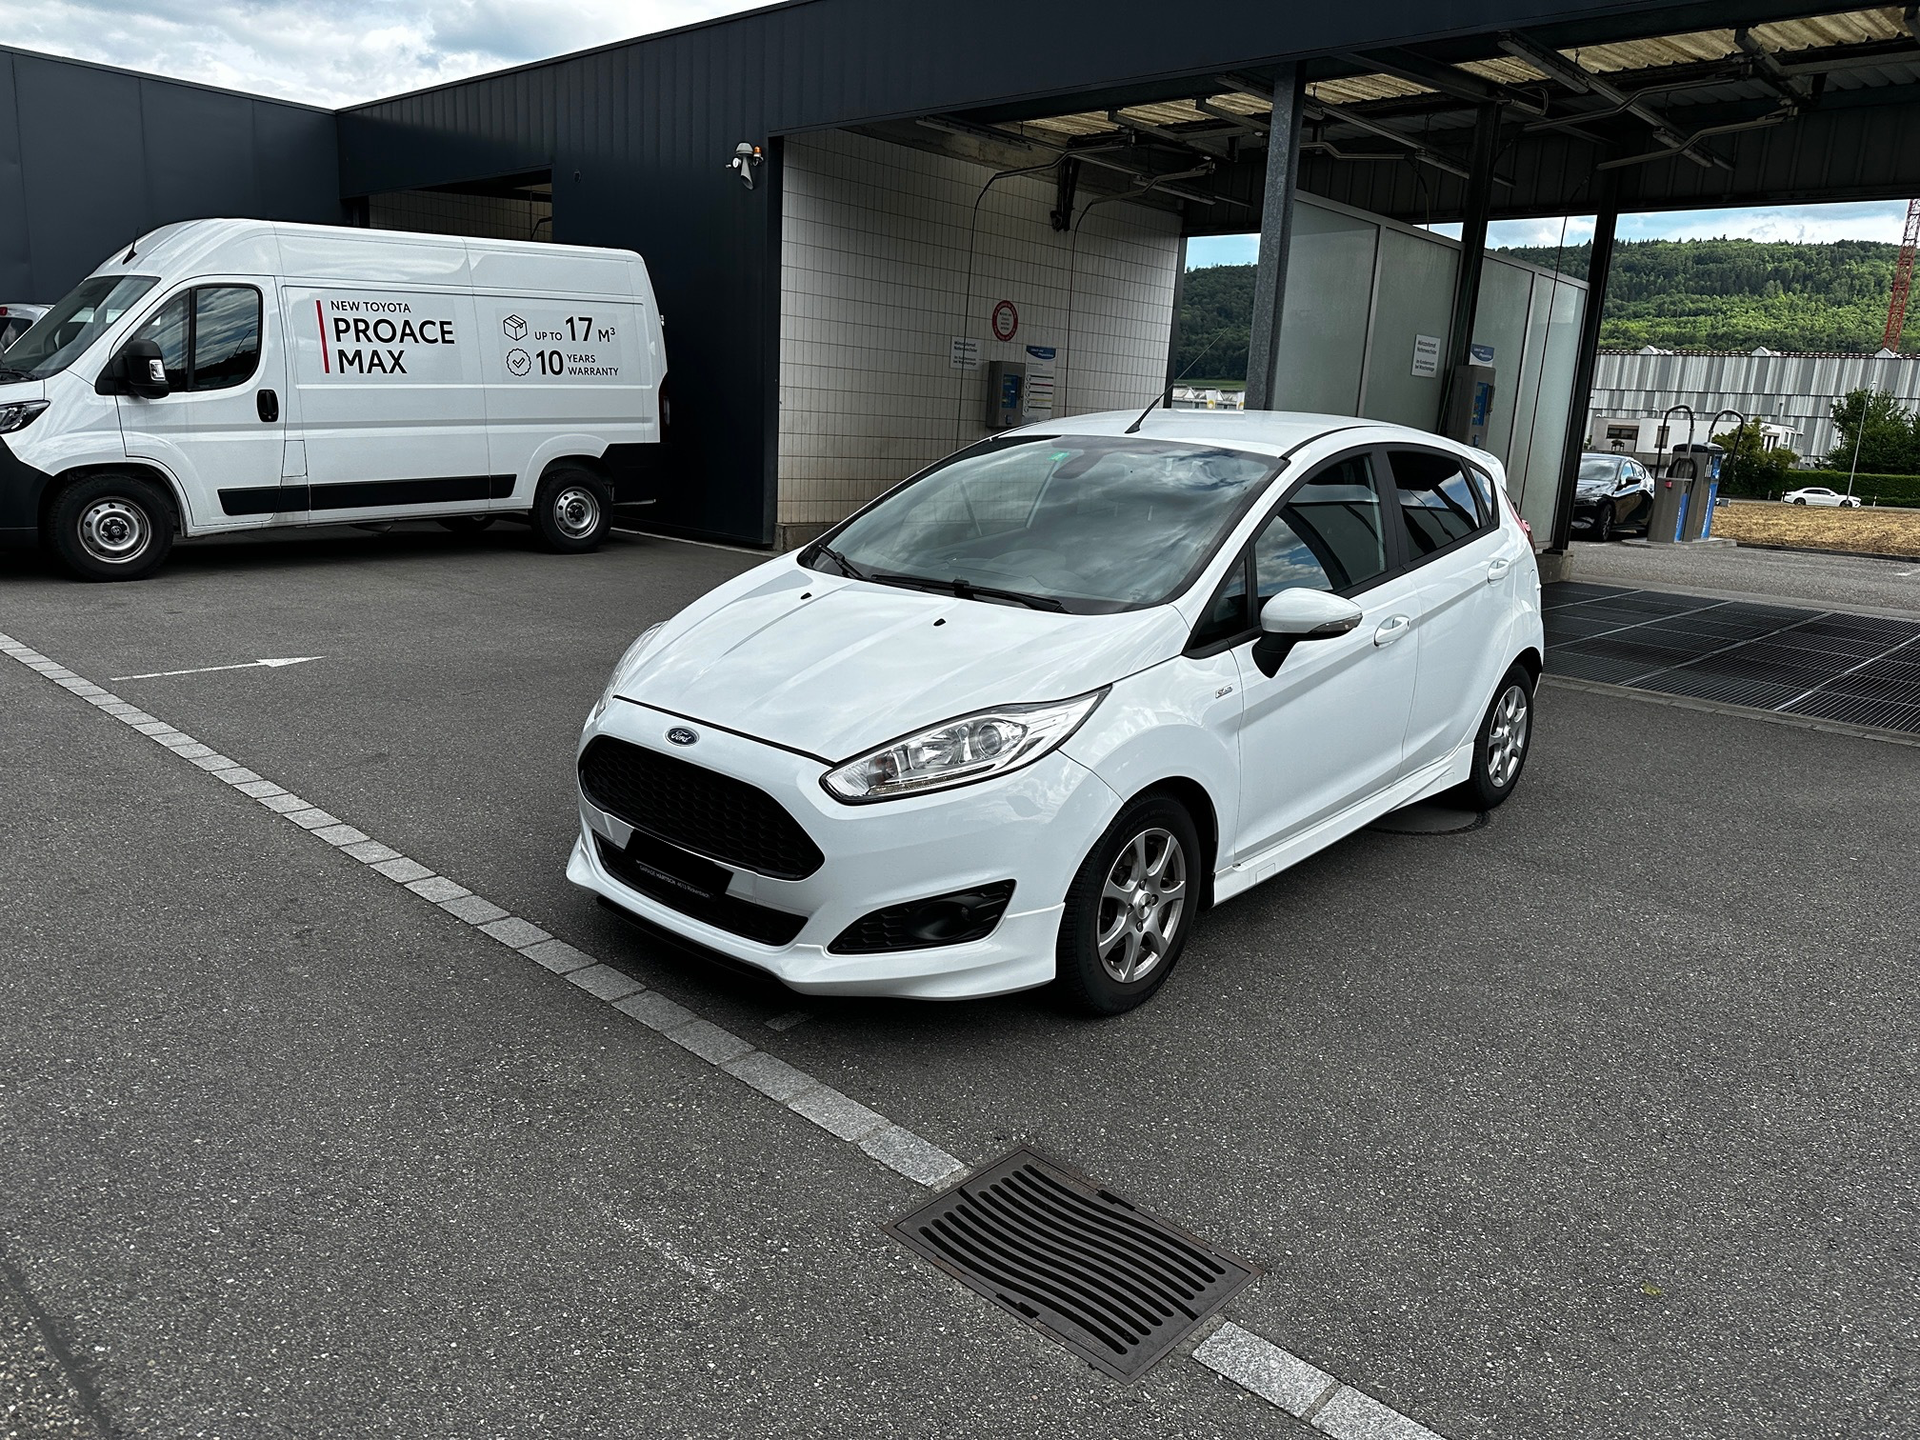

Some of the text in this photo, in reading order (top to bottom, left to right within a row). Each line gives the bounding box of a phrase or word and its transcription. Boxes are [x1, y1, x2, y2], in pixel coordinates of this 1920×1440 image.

[330, 300, 411, 313] NEW TOYOTA
[333, 317, 455, 345] PROACE
[534, 331, 546, 341] UP
[547, 331, 563, 342] TO
[565, 316, 593, 342] 17
[337, 349, 408, 374] MAX
[535, 349, 596, 376] 10 YEARS
[567, 366, 619, 376] WARRANTY
